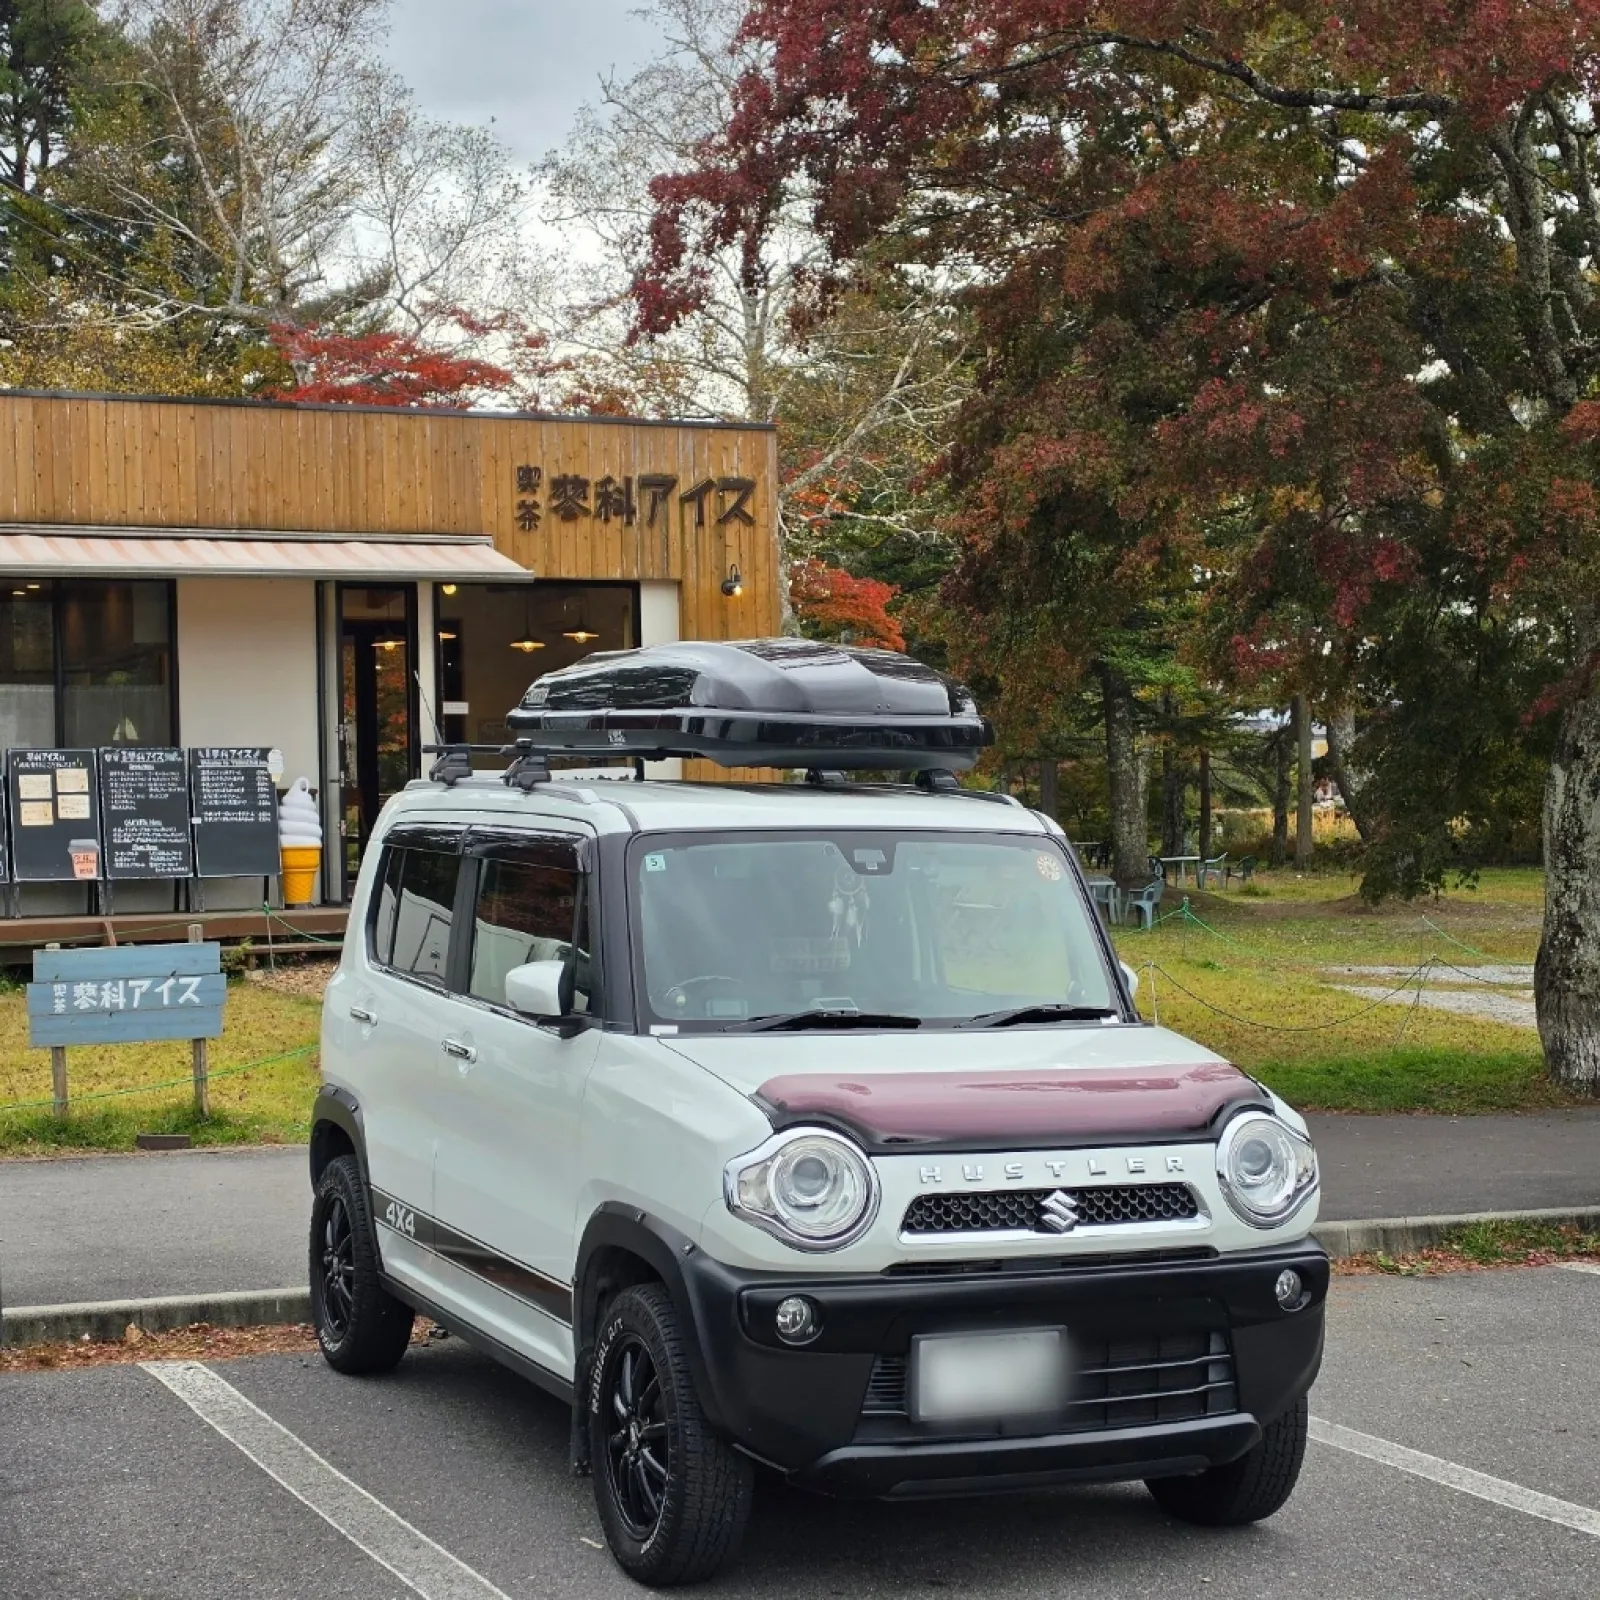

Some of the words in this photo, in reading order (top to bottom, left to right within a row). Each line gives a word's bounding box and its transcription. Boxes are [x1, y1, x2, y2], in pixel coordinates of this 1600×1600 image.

[515, 464, 541, 531] 喫茶
[549, 473, 756, 527] 蓼科アイス
[53, 983, 67, 1013] 喫茶
[73, 977, 202, 1010] 蓼科アイス
[919, 1155, 1185, 1184] HUSTLER
[386, 1202, 416, 1238] 4X4
